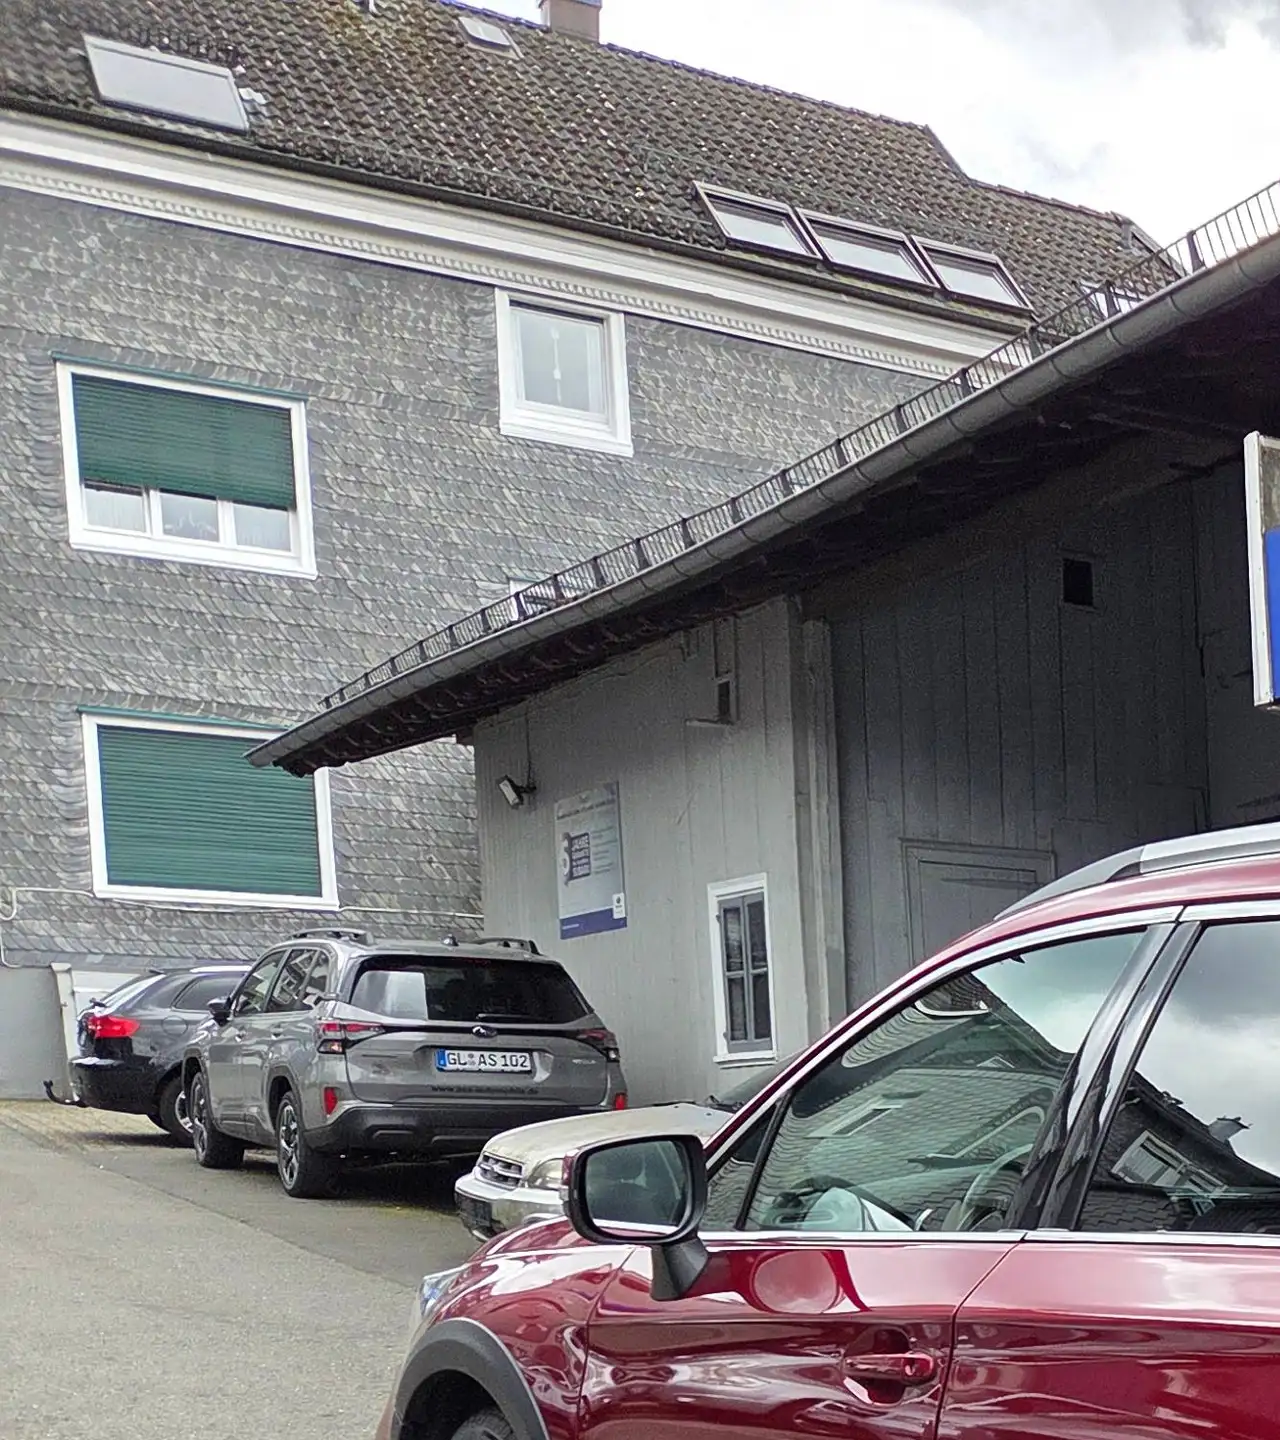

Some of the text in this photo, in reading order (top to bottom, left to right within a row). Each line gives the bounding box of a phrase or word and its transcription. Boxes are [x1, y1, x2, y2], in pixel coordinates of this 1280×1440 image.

[447, 1052, 529, 1068] GL AS 102
